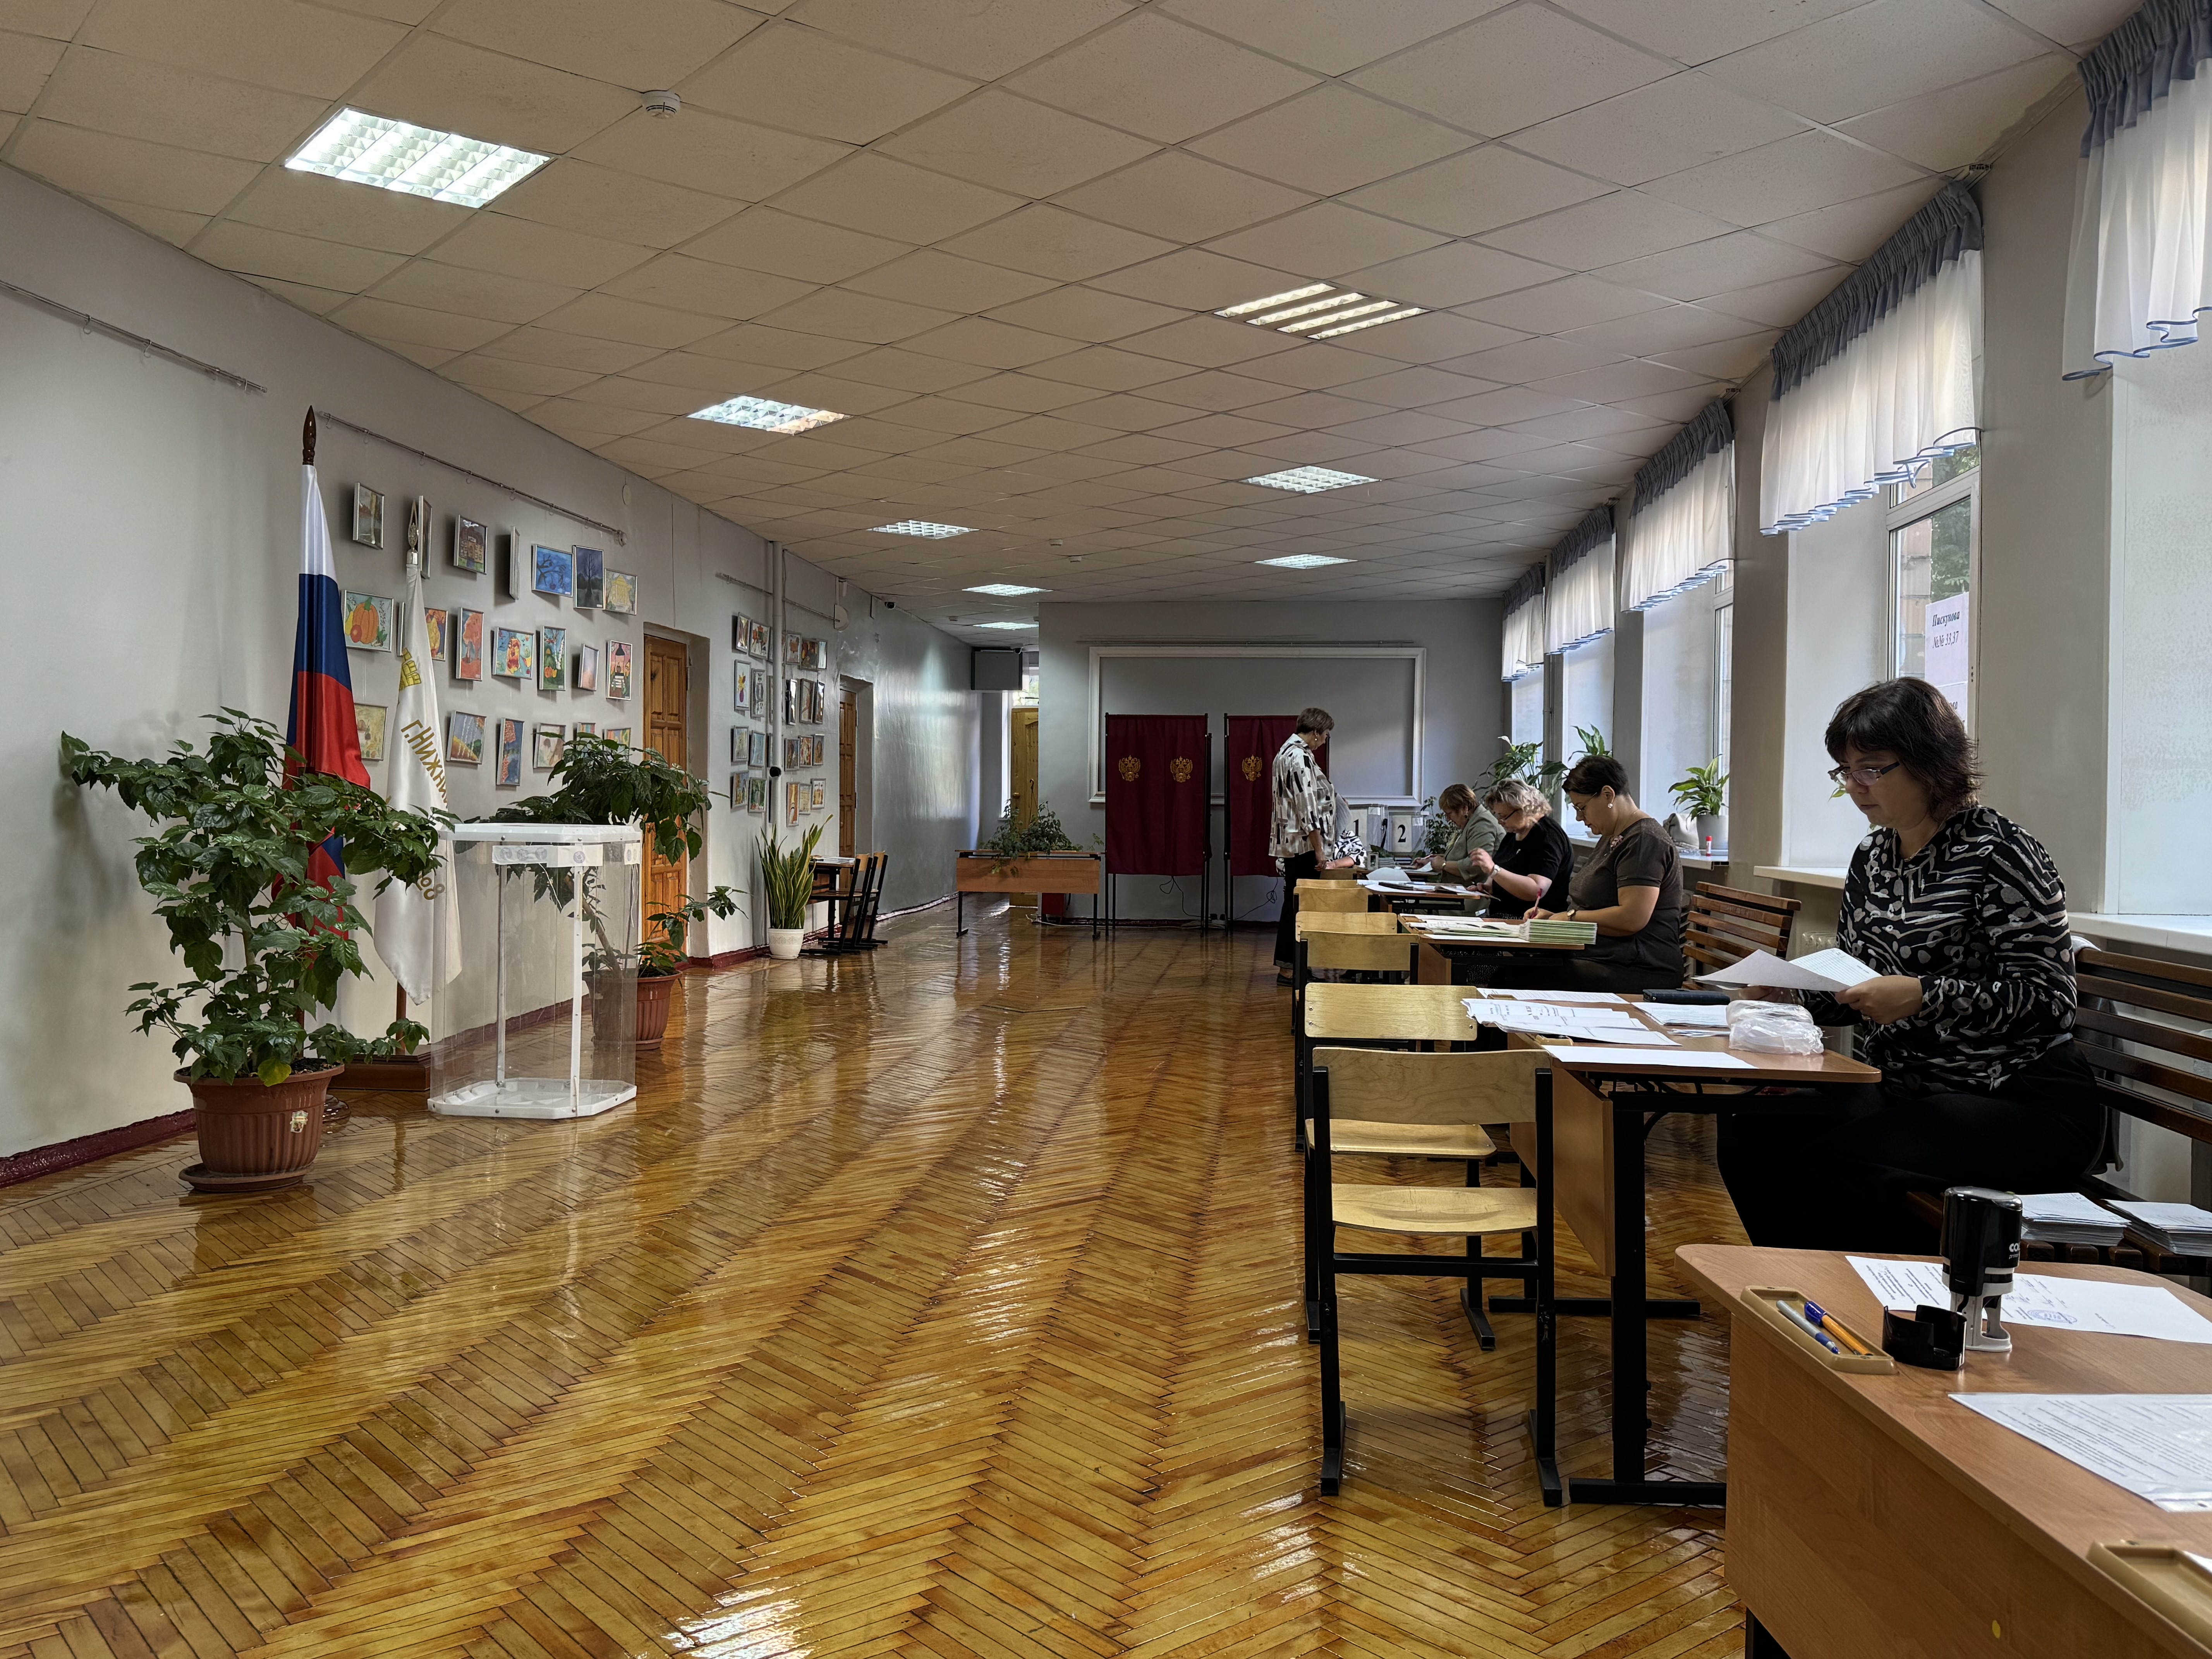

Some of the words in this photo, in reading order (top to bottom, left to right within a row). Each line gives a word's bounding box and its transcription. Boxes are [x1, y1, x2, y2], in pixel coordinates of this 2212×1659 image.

[1932, 611, 1960, 627] Пискунова
[1945, 631, 1959, 646] 33,37
[1353, 819, 1359, 836] 1
[1398, 824, 1406, 842] 2
